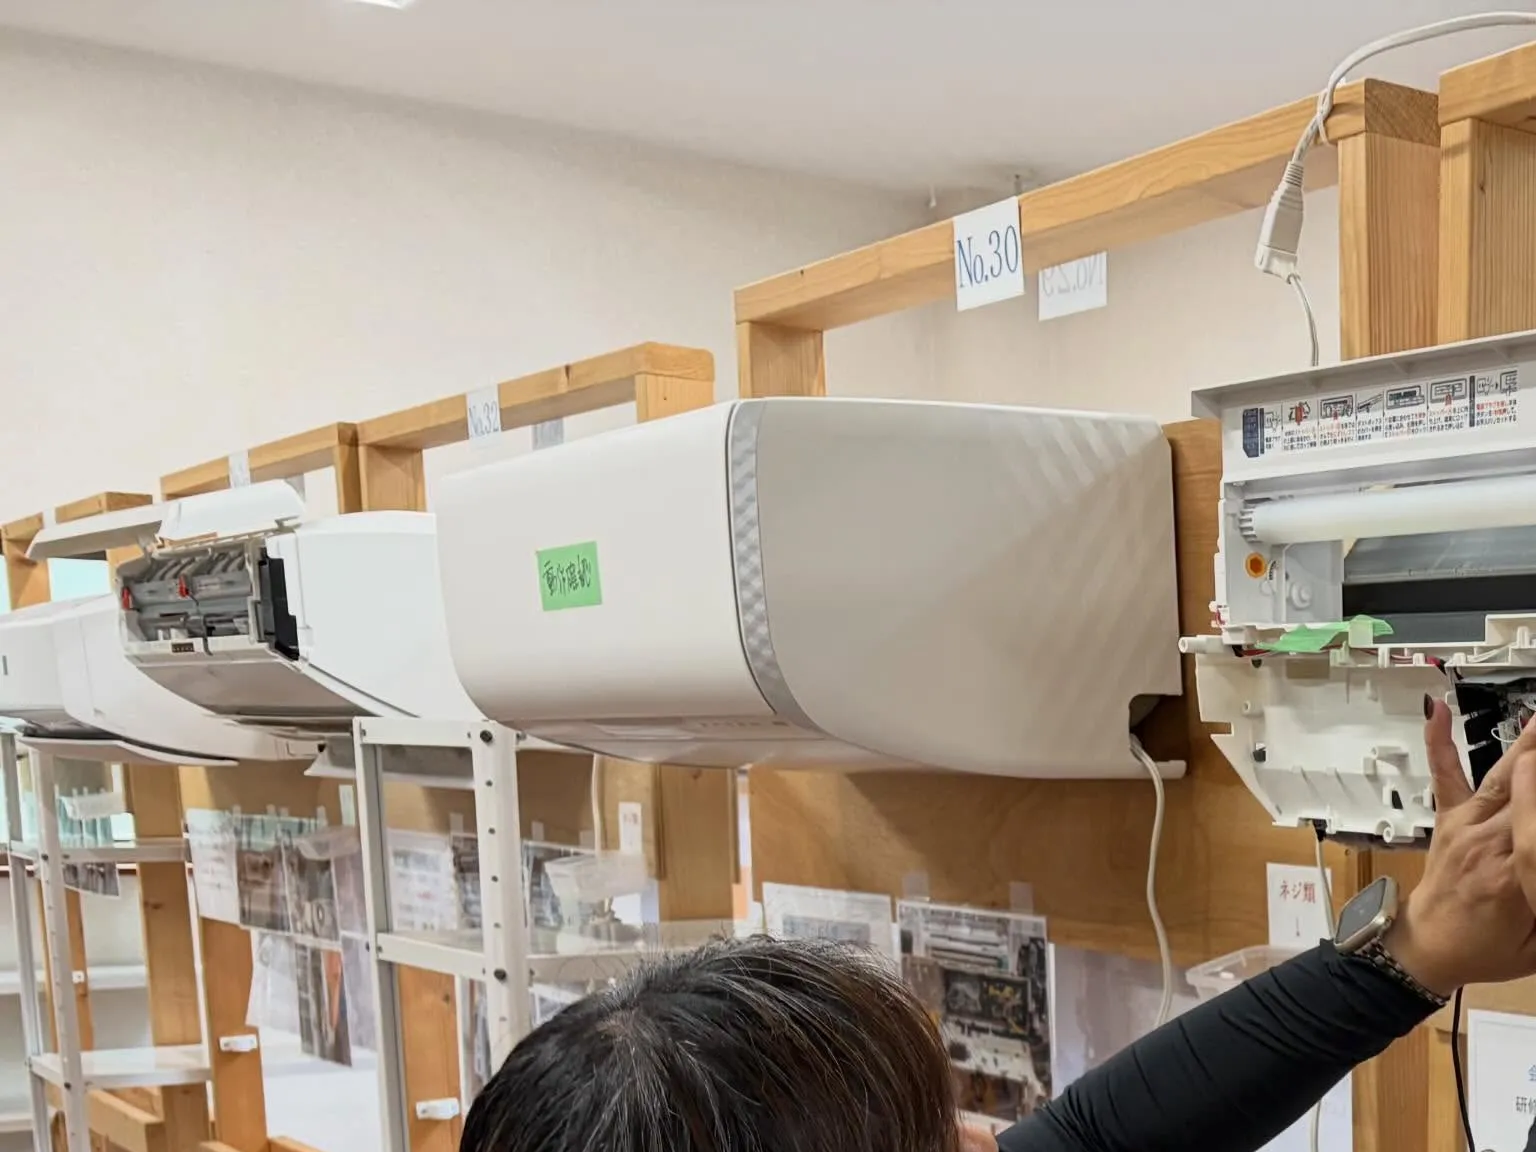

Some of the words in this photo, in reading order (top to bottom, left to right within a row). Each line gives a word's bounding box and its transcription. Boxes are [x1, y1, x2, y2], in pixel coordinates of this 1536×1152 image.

[957, 225, 1019, 288] No.30
[1279, 880, 1316, 904] ネジ類
